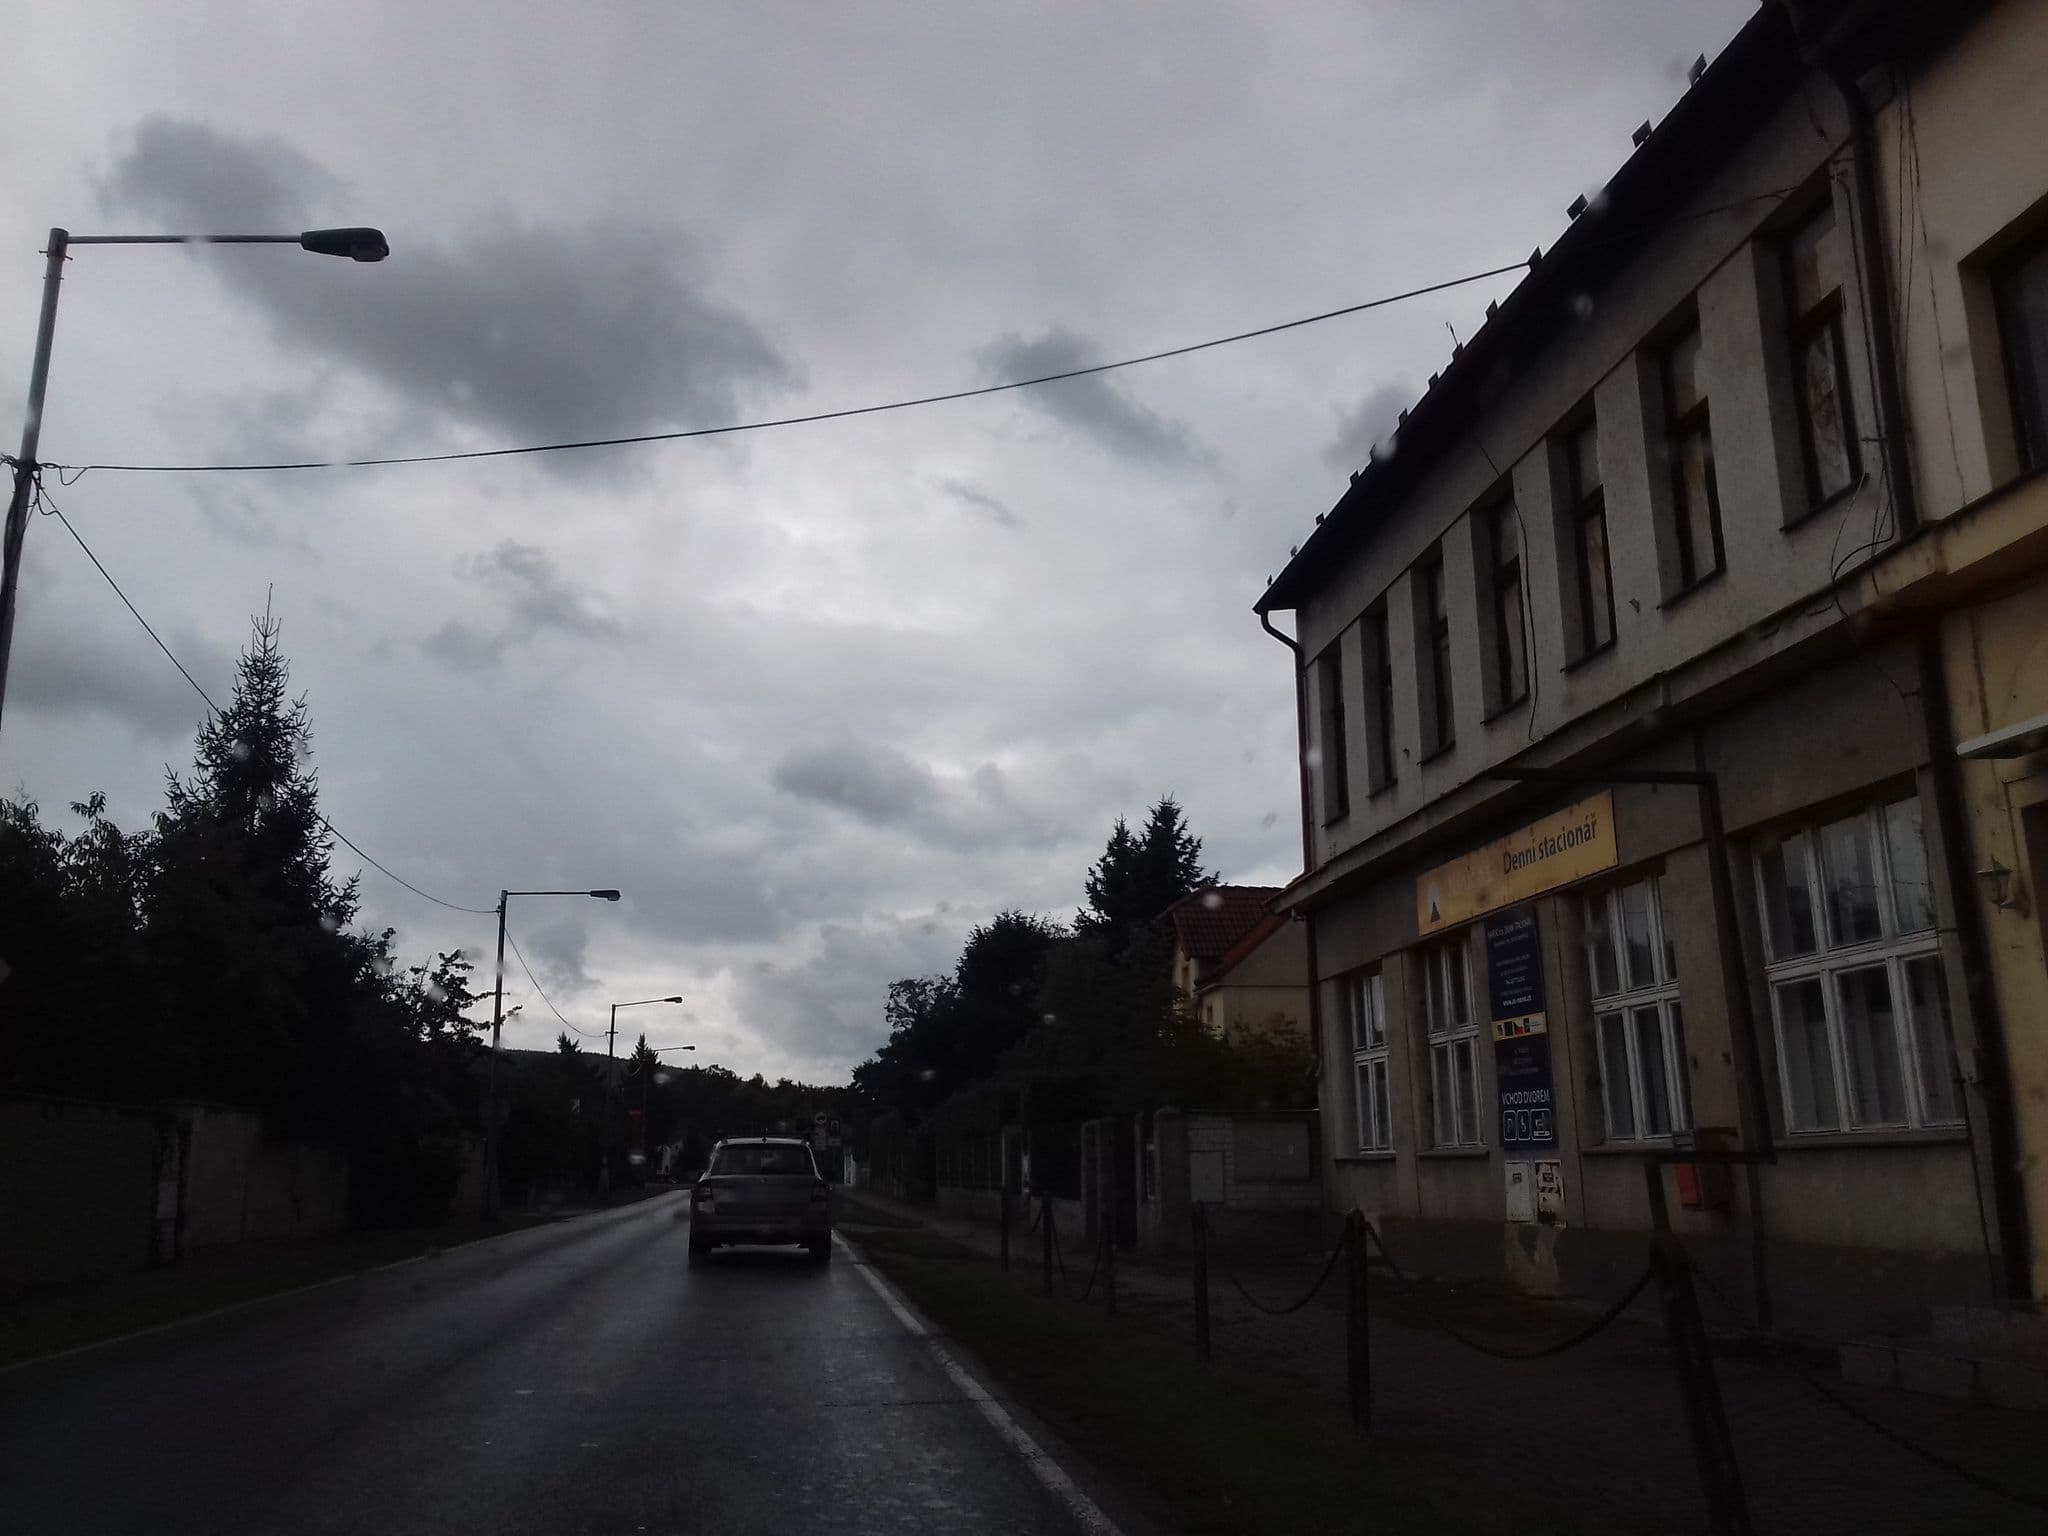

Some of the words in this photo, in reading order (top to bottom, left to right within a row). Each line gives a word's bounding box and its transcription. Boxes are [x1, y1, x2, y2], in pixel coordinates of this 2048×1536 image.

[1503, 837, 1536, 875] Denní
[1537, 812, 1598, 860] stacionář
[1501, 1091, 1523, 1105] VCHOD
